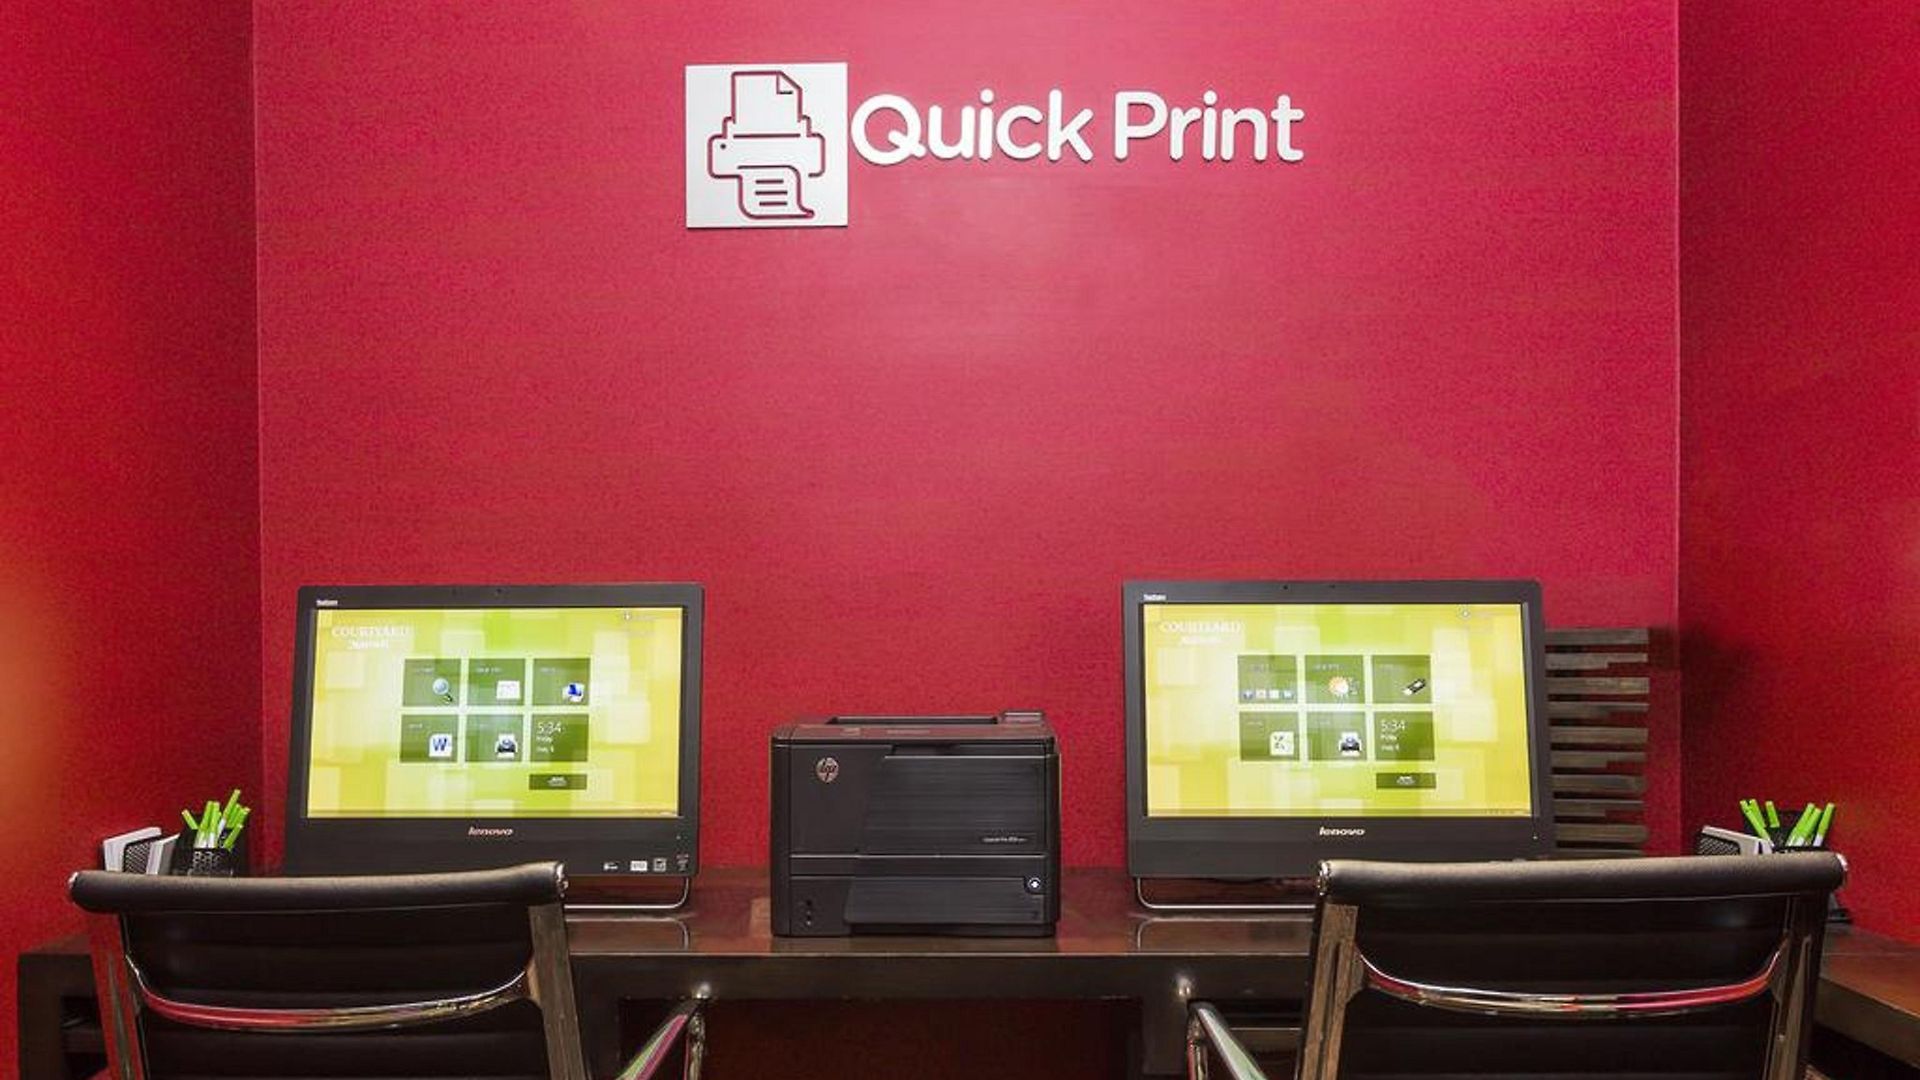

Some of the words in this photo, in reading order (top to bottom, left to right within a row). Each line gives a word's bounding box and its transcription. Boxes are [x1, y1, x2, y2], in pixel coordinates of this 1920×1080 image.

[850, 88, 1094, 166] Quick
[1112, 90, 1306, 162] Print
[1380, 719, 1405, 733] 5:34
[468, 826, 513, 836] lenovo
[1319, 826, 1365, 836] lenovo
